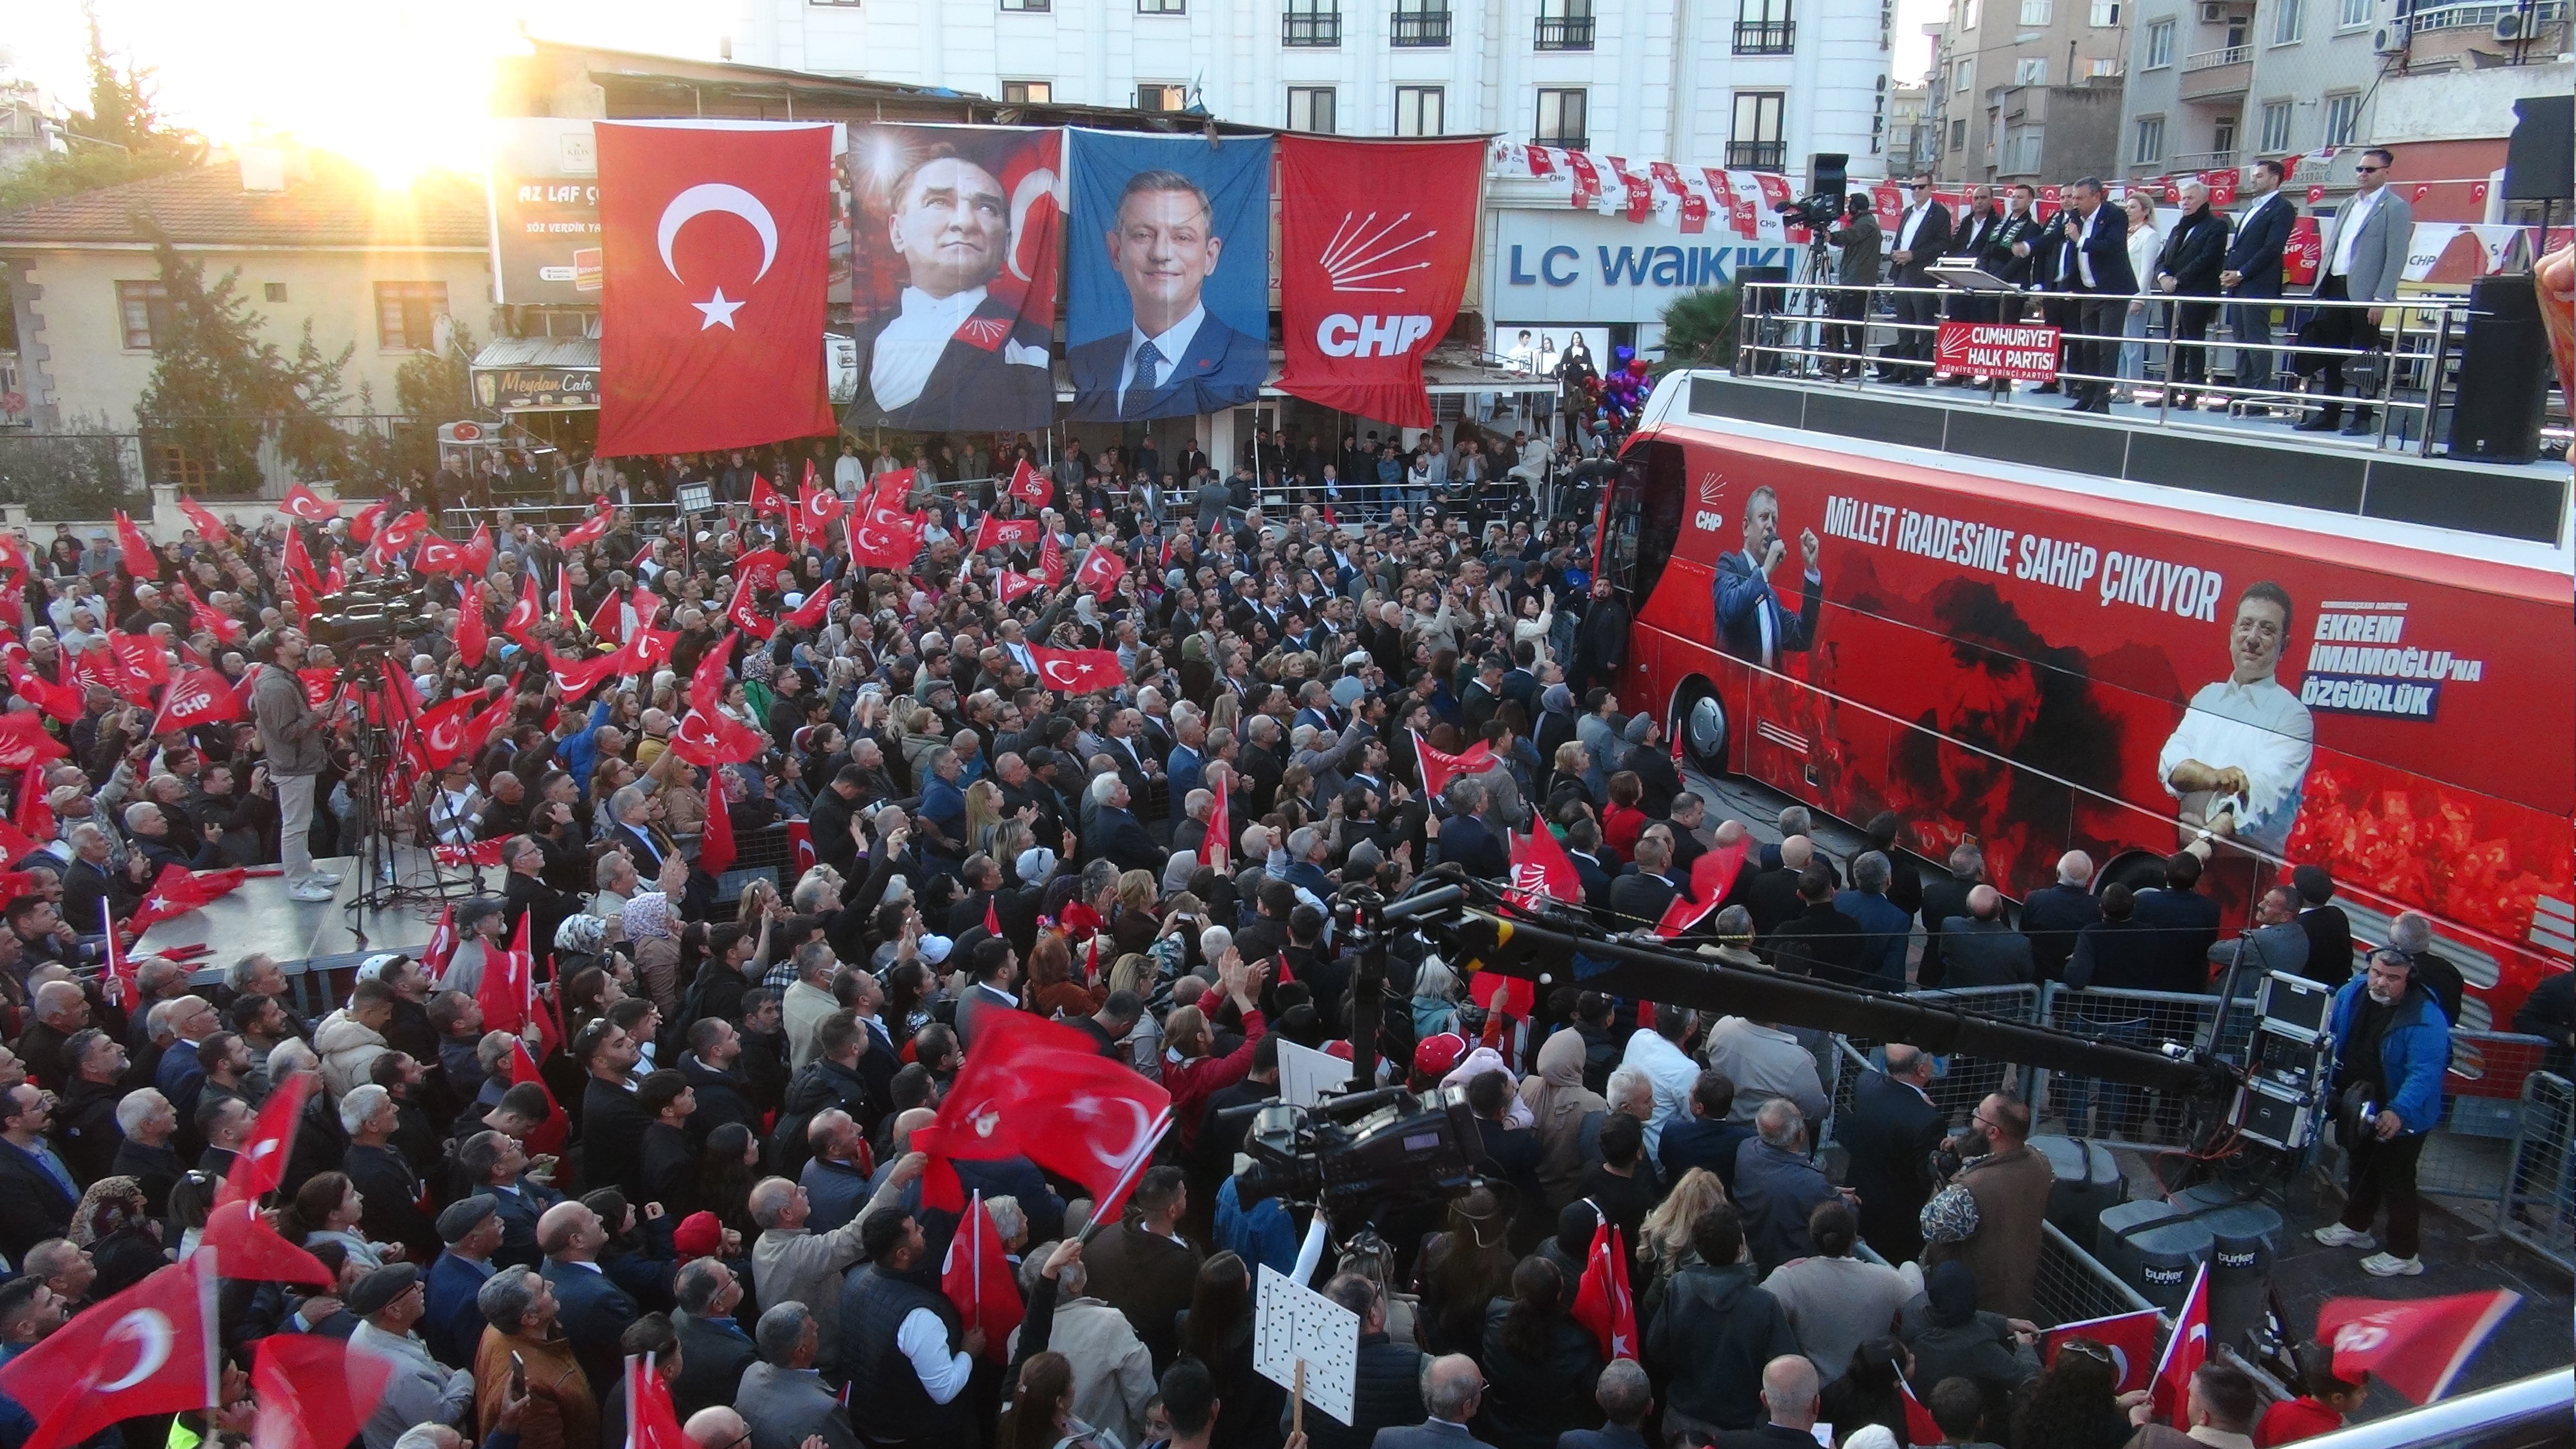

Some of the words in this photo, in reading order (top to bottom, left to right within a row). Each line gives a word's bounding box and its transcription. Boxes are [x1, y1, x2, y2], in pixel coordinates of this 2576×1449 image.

[1871, 74, 1886, 154] OTEL
[517, 185, 543, 203] AZ
[547, 185, 581, 203] LAF
[586, 186, 599, 206] Ç
[526, 221, 545, 233] SÖZ
[548, 221, 586, 233] VERDİK
[1736, 212, 1752, 220] CHP
[1759, 219, 1777, 228] CHP
[1882, 234, 1893, 243] HP
[2283, 243, 2303, 254] HP
[1510, 244, 1580, 287] LC
[2409, 255, 2437, 266] CHP
[1317, 313, 1432, 358] CHP
[1971, 326, 2056, 348] CUMHURİYET
[1967, 347, 2003, 366] HALK
[2005, 350, 2055, 371] PARTİSİ
[501, 371, 561, 397] Meydan
[562, 373, 593, 392] Cafe
[2021, 371, 2053, 380] PARTİSİ
[1026, 483, 1042, 496] CHP
[1695, 510, 1722, 532] CHP
[997, 529, 1022, 541] CHP
[1823, 495, 1897, 547] MİLLET
[1896, 507, 2015, 575] İRADESİNE
[2015, 533, 2098, 592] SAHİP
[2099, 550, 2223, 623] ÇIKIYOR
[1007, 580, 1028, 593] CHP
[2314, 613, 2405, 643] EKREM
[2307, 642, 2482, 682] İMAMOĞLU'NA
[171, 693, 211, 717] CHP
[2300, 675, 2434, 715] ÖZGÜRLÜK
